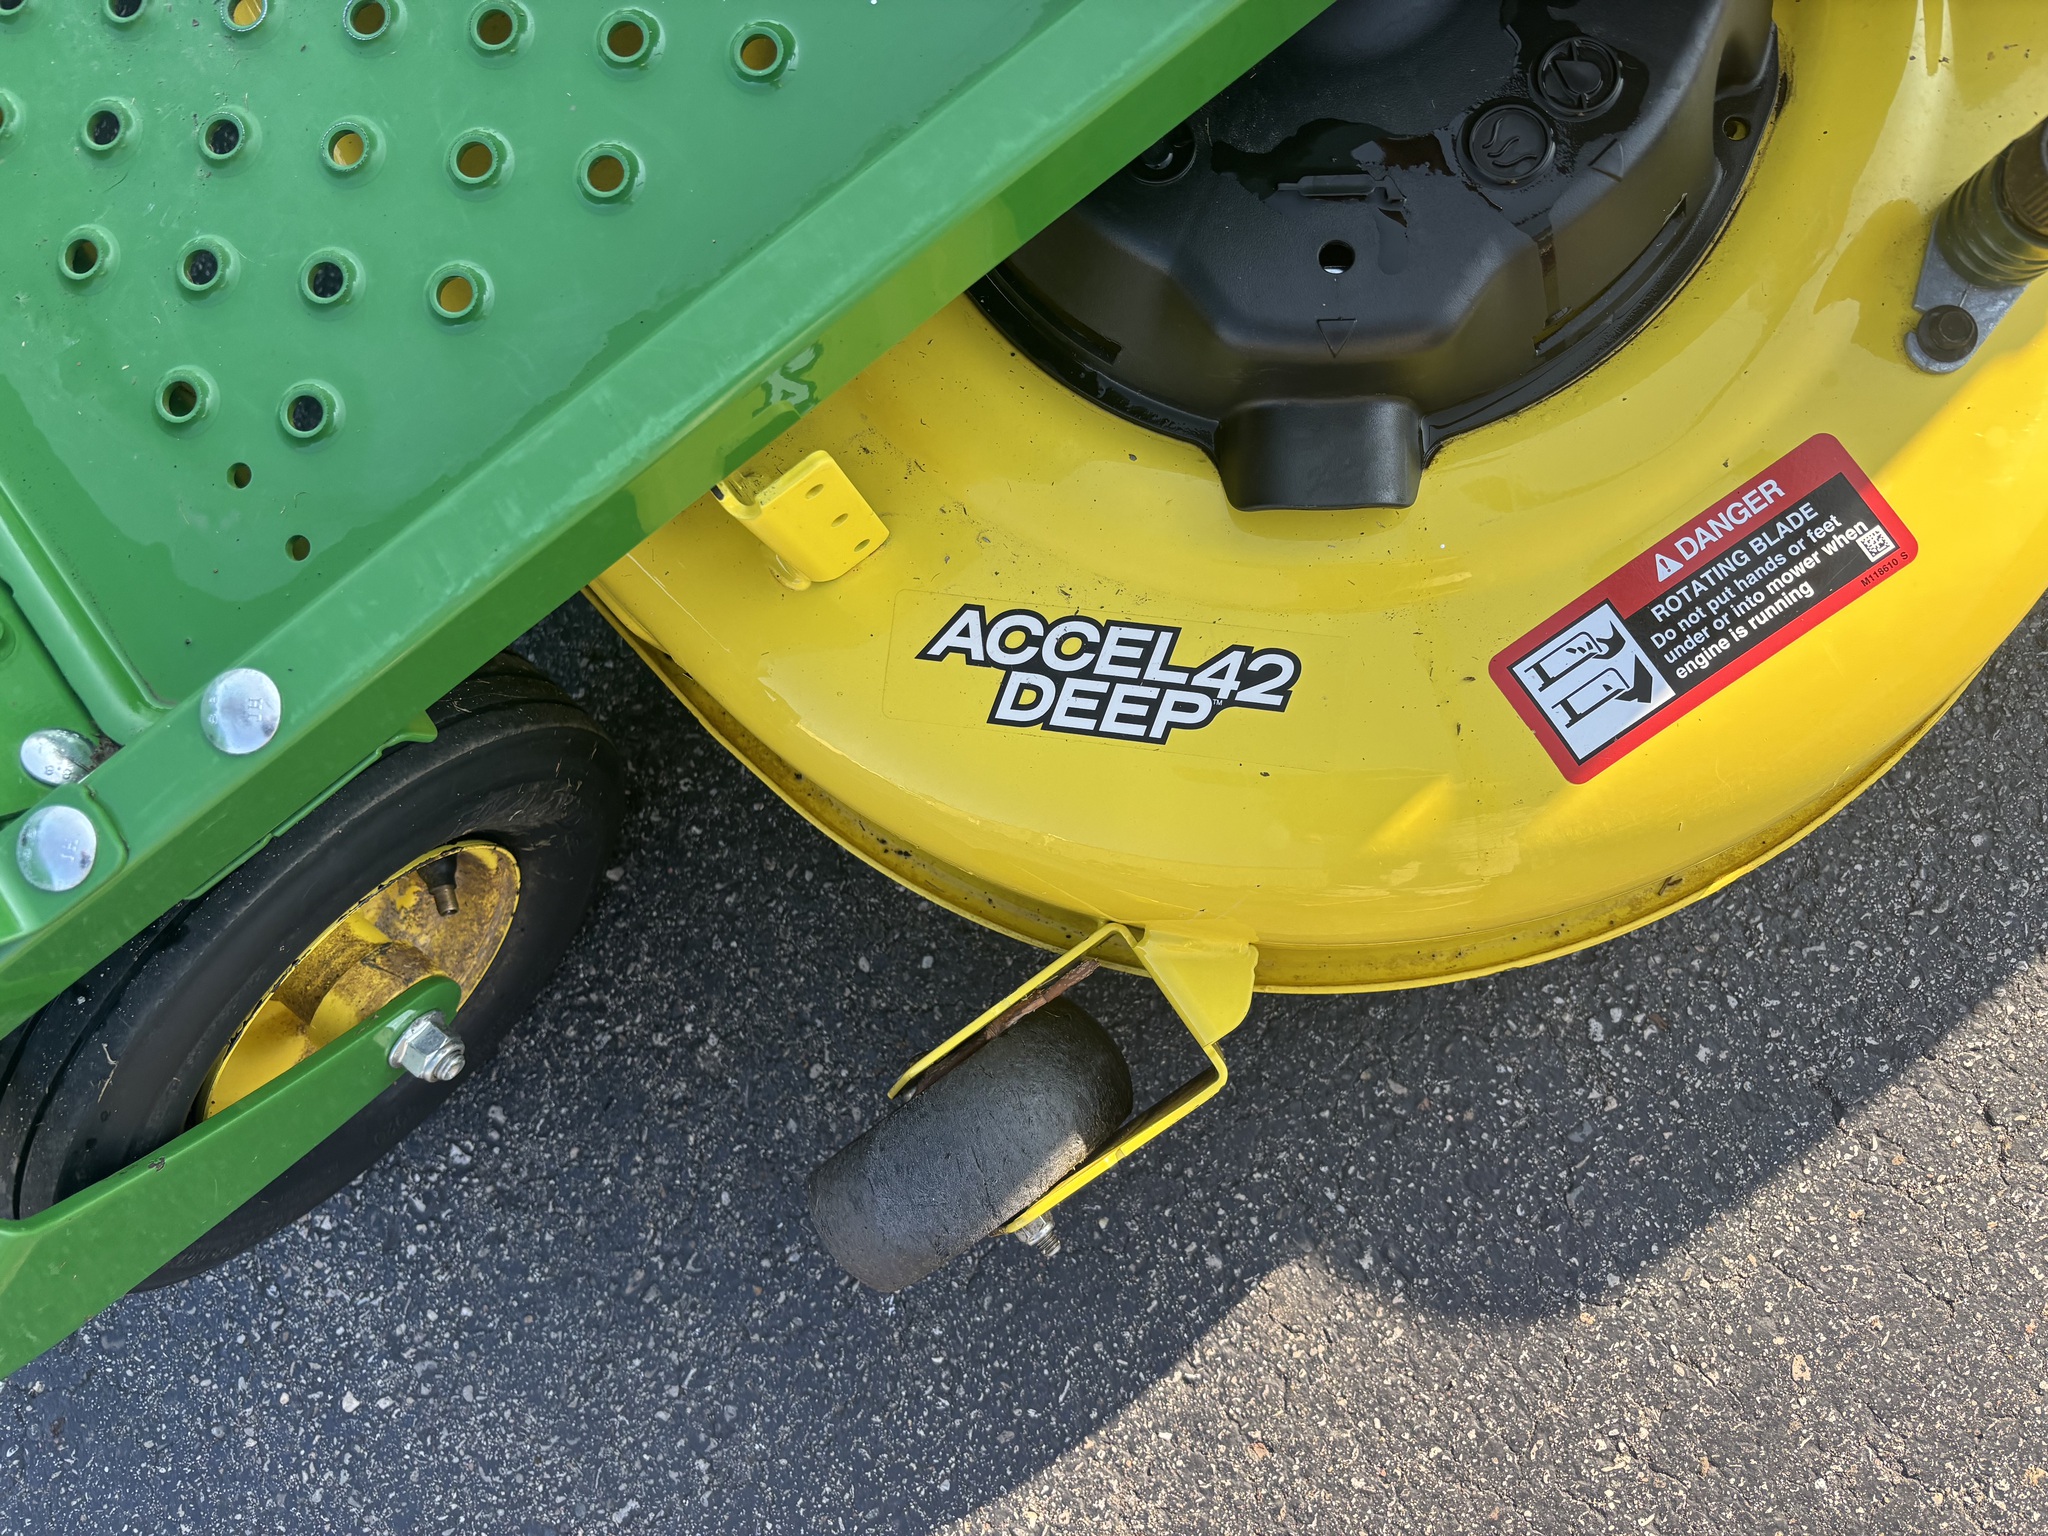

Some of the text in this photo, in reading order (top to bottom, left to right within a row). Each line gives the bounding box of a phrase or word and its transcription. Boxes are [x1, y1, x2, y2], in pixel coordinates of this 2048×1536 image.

[1650, 501, 1819, 623] ROTATING BLADE
[1674, 479, 1786, 561] DANGER
[1860, 551, 1909, 587] M118610 S
[1650, 514, 1843, 649] Do not put hands or feet
[1663, 520, 1870, 664] under or into mower when
[1675, 580, 1816, 680] engine is running
[926, 608, 1295, 706] ACCEL 42
[994, 670, 1213, 739] DEEP
